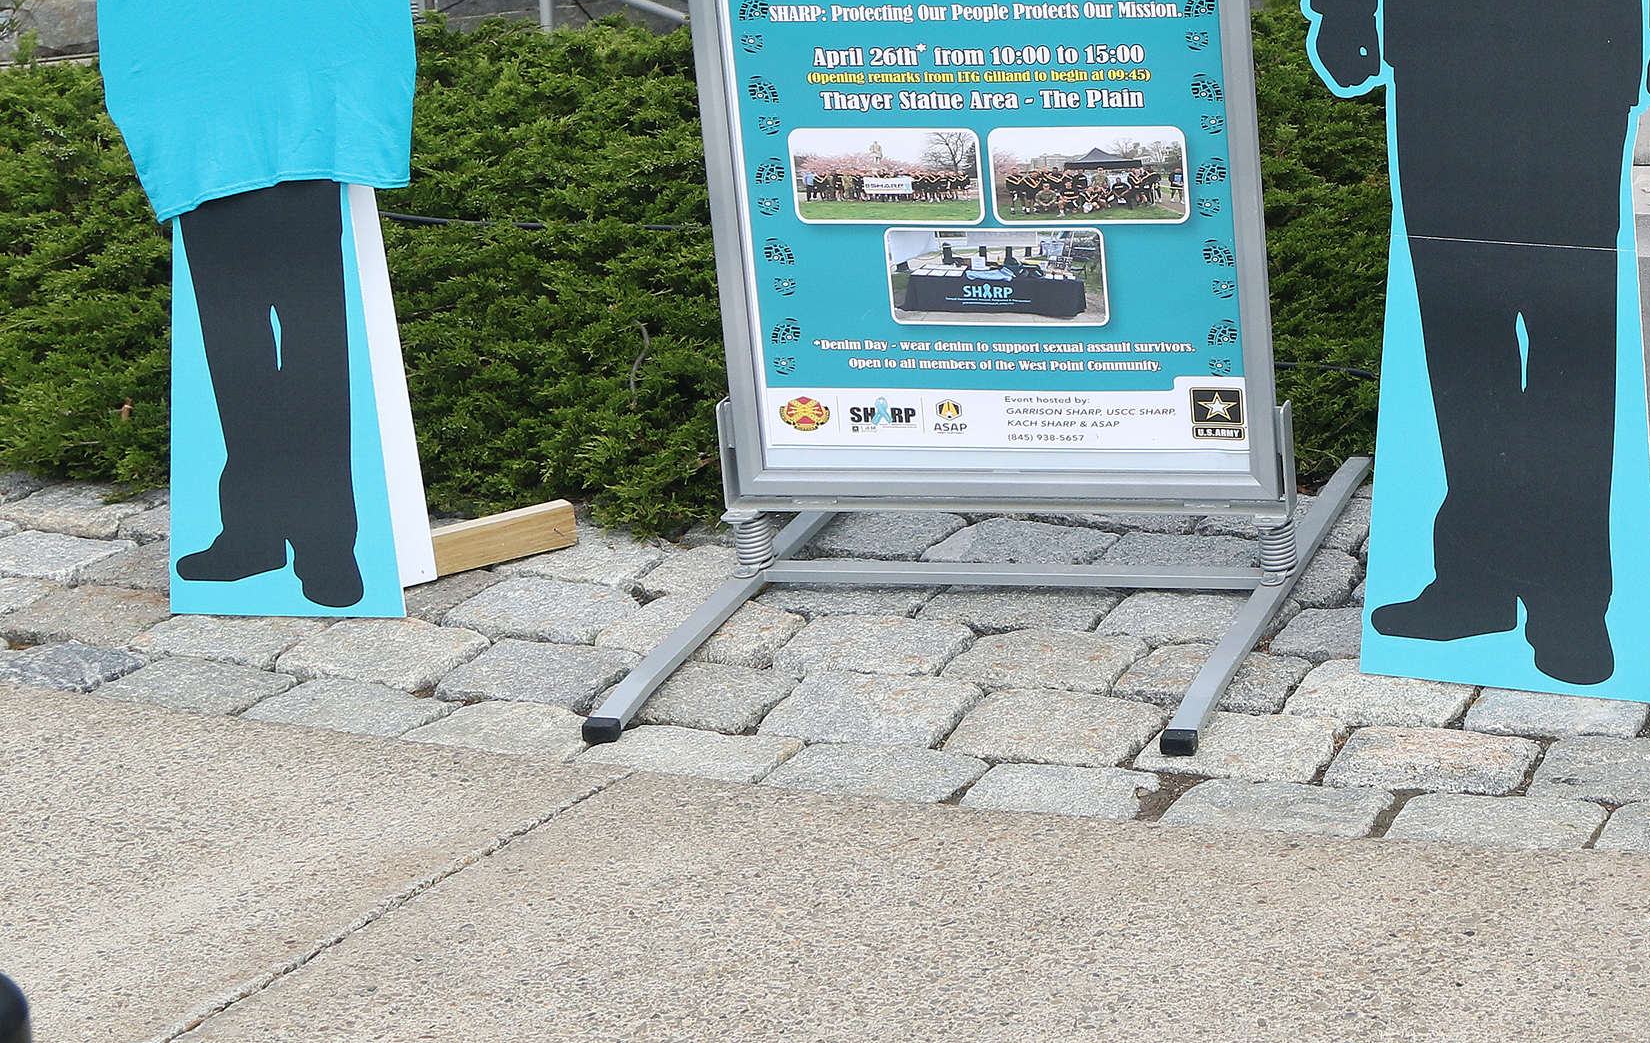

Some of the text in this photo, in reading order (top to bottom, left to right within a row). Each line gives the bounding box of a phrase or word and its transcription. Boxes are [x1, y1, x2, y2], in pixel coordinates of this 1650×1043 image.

[767, 0, 1184, 23] SHARP: Protecting Our People Protects Our Mission.
[812, 46, 865, 69] April
[932, 46, 986, 66] from
[988, 44, 1054, 66] 10:00
[1055, 44, 1079, 64] to
[1082, 43, 1147, 64] 15:00
[806, 68, 1151, 85] (Opening remarks from LTG Gilland to begin at 09:45)
[818, 90, 894, 112] Thayer
[897, 90, 964, 110] Statue
[968, 90, 1020, 110] Area
[1038, 88, 1081, 109] The
[1084, 88, 1145, 108] Plain
[862, 338, 888, 352] Day
[898, 340, 932, 351] wear
[933, 339, 975, 352] denim
[975, 340, 990, 353] to
[991, 341, 1042, 354] support
[1041, 341, 1084, 353] sexual
[1085, 341, 1132, 353] assault
[1132, 341, 1196, 353] survivors.
[847, 356, 1162, 372] Open to all members of the West Point Community.
[1074, 396, 1091, 405] by:
[1006, 407, 1062, 415] GARRISON
[934, 423, 967, 432] ASAP
[1007, 433, 1084, 441] (845) 938-5657
